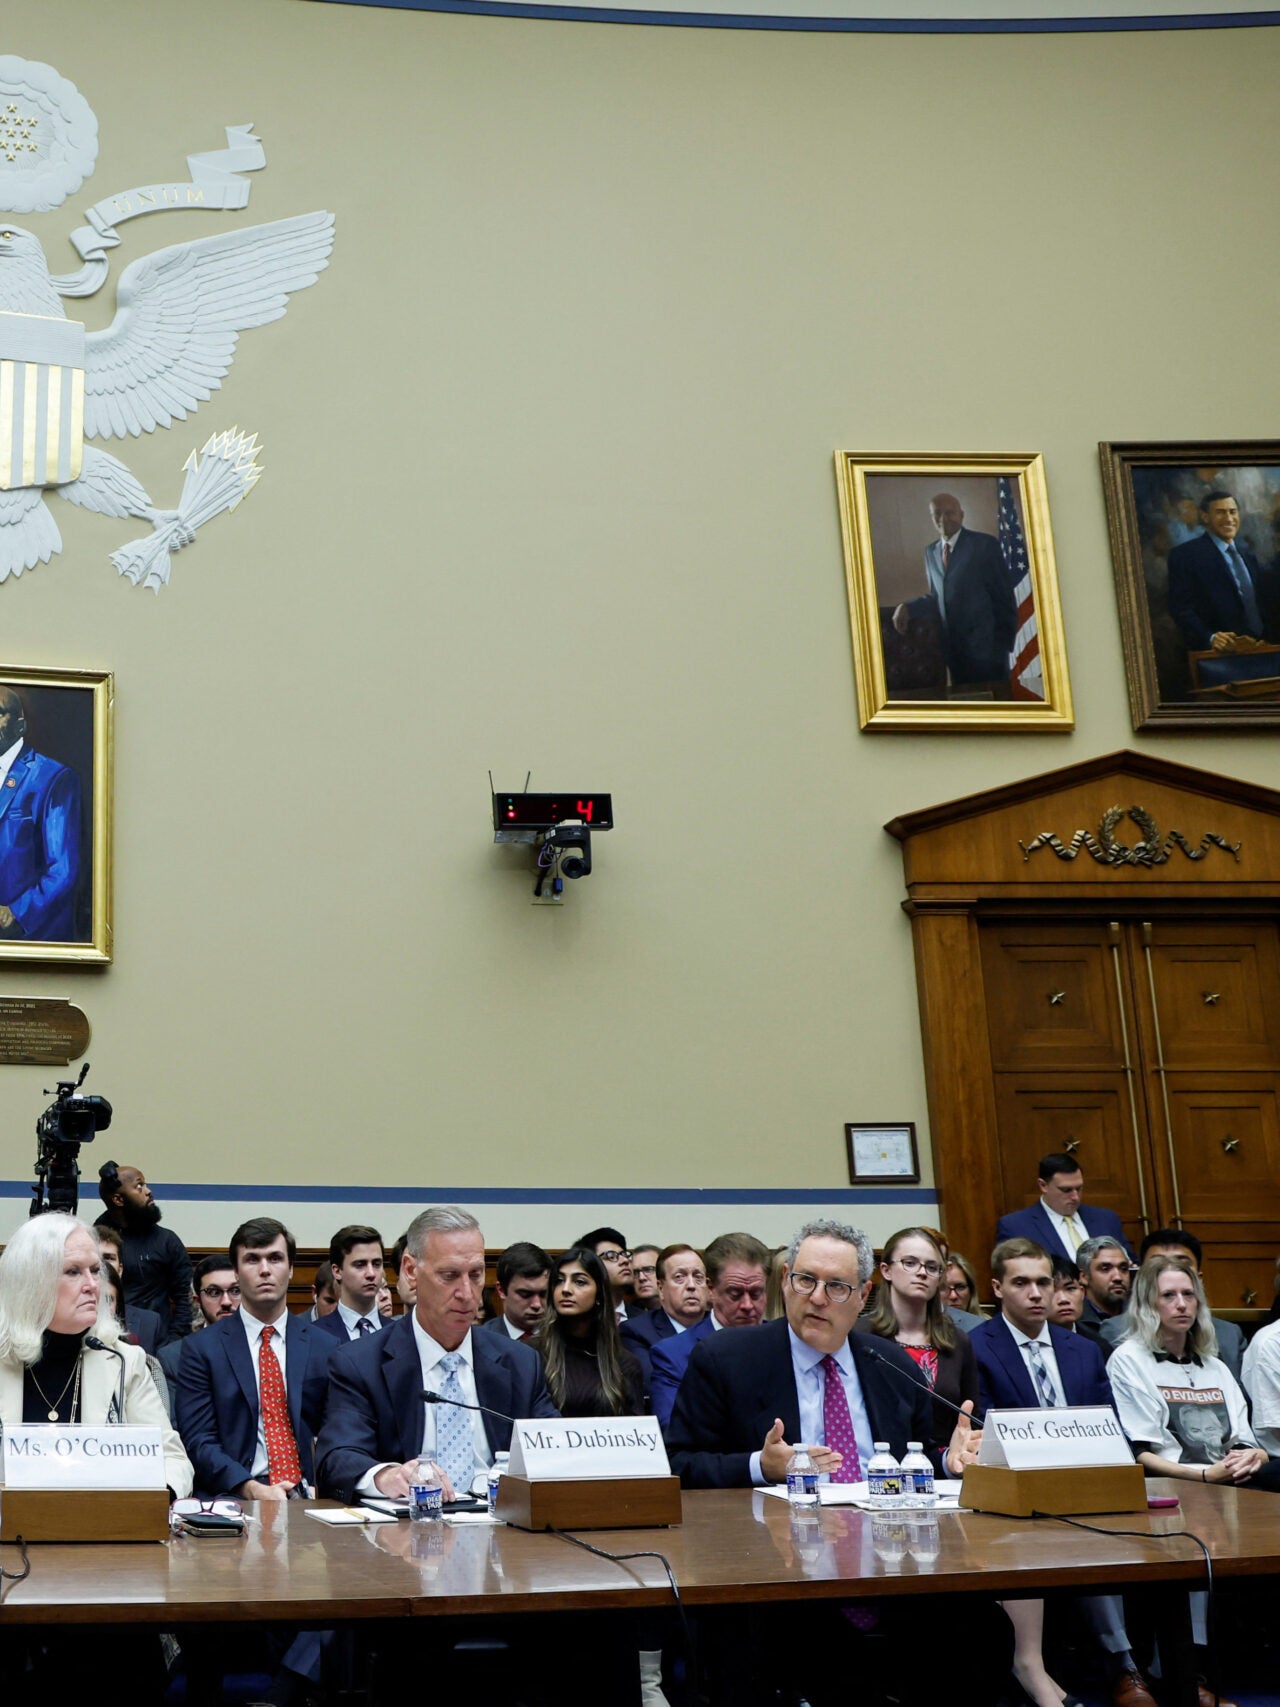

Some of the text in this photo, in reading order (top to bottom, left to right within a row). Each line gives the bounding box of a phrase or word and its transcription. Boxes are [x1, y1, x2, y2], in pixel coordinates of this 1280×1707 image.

[113, 187, 206, 214] UNUM
[577, 800, 593, 822] 4
[523, 1428, 658, 1451] Mr. Dubinsky
[996, 1416, 1121, 1441] Prof. Gerhardt
[9, 1437, 160, 1457] Ms. O'Connor
